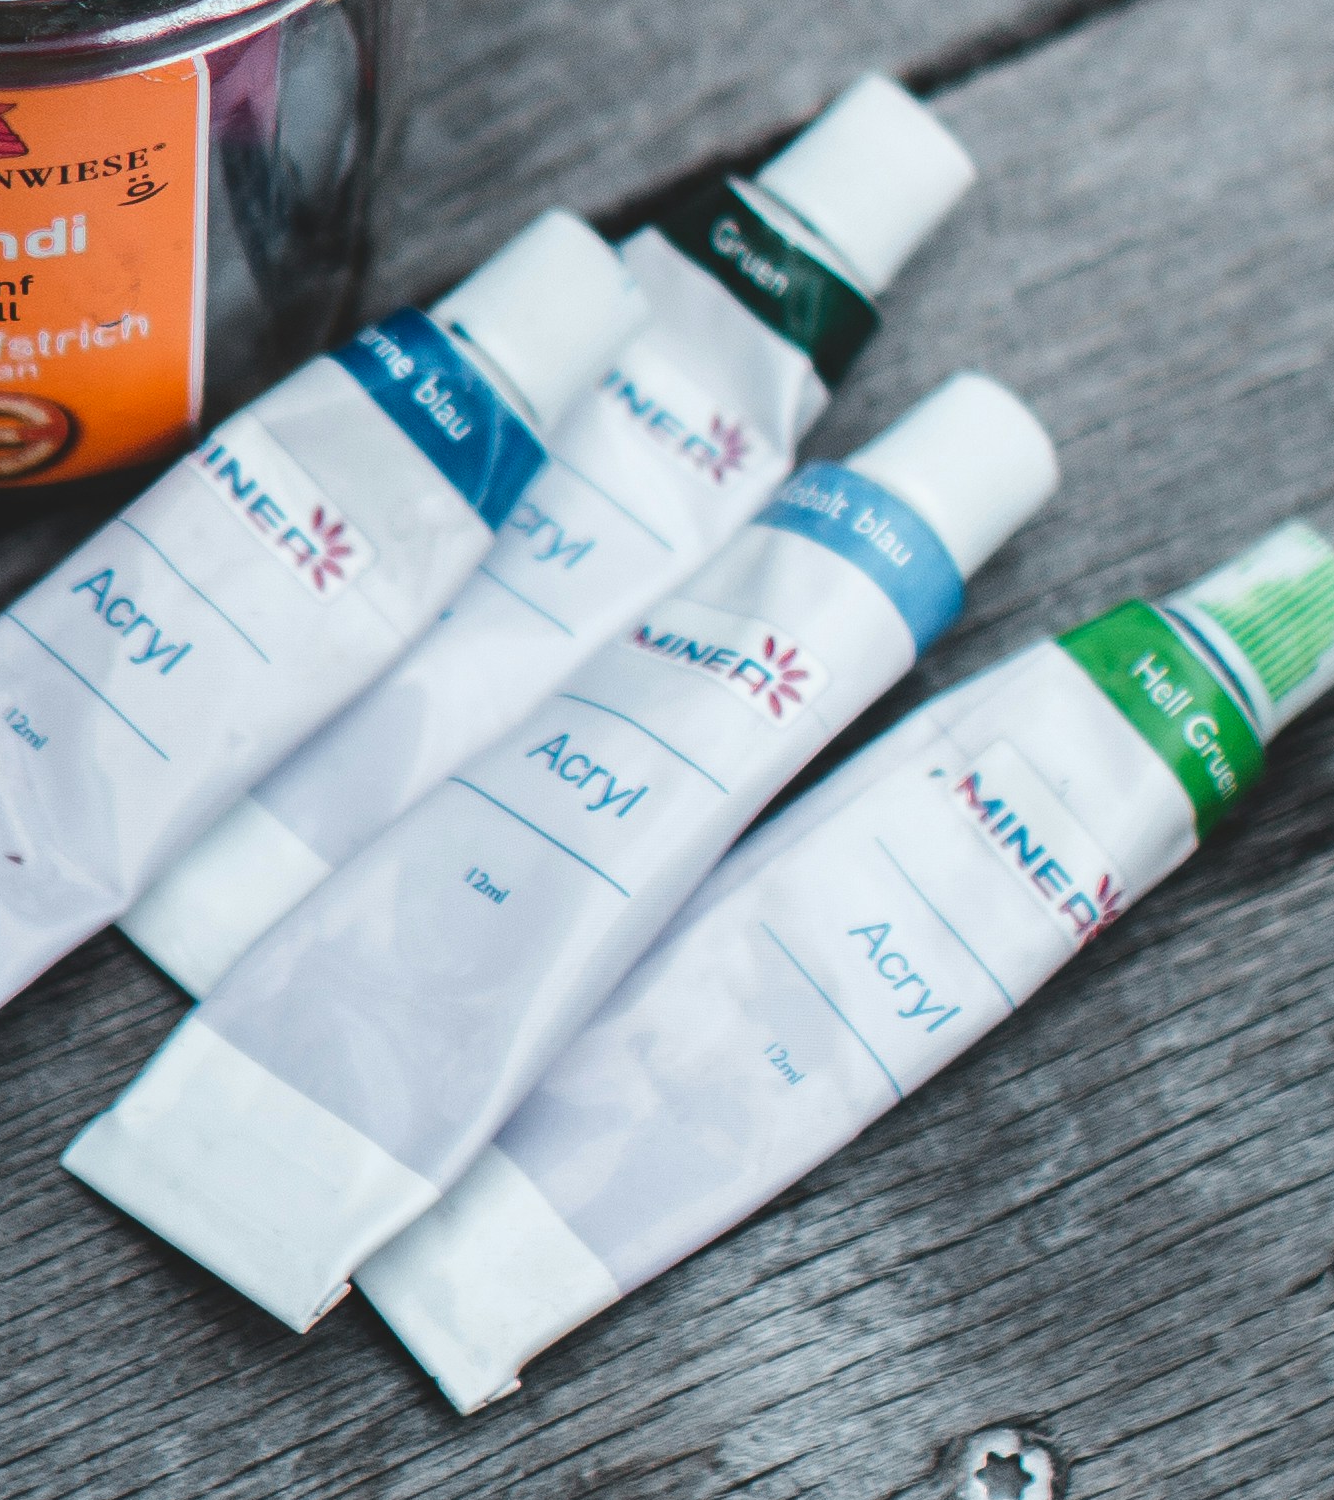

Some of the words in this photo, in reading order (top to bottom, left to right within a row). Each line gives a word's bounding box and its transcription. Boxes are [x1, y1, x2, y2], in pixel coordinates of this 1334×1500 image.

[414, 376, 472, 441] blau
[508, 502, 596, 569] cryl
[852, 508, 913, 566] blau
[72, 567, 192, 675] Acryl
[4, 708, 49, 751] 12ml
[1132, 653, 1193, 719] Hell
[1184, 715, 1239, 801] Gruen
[526, 733, 649, 818] Acryl
[463, 867, 510, 905] 12ml
[848, 922, 962, 1033] Acryl
[764, 1042, 806, 1086] 12ml
